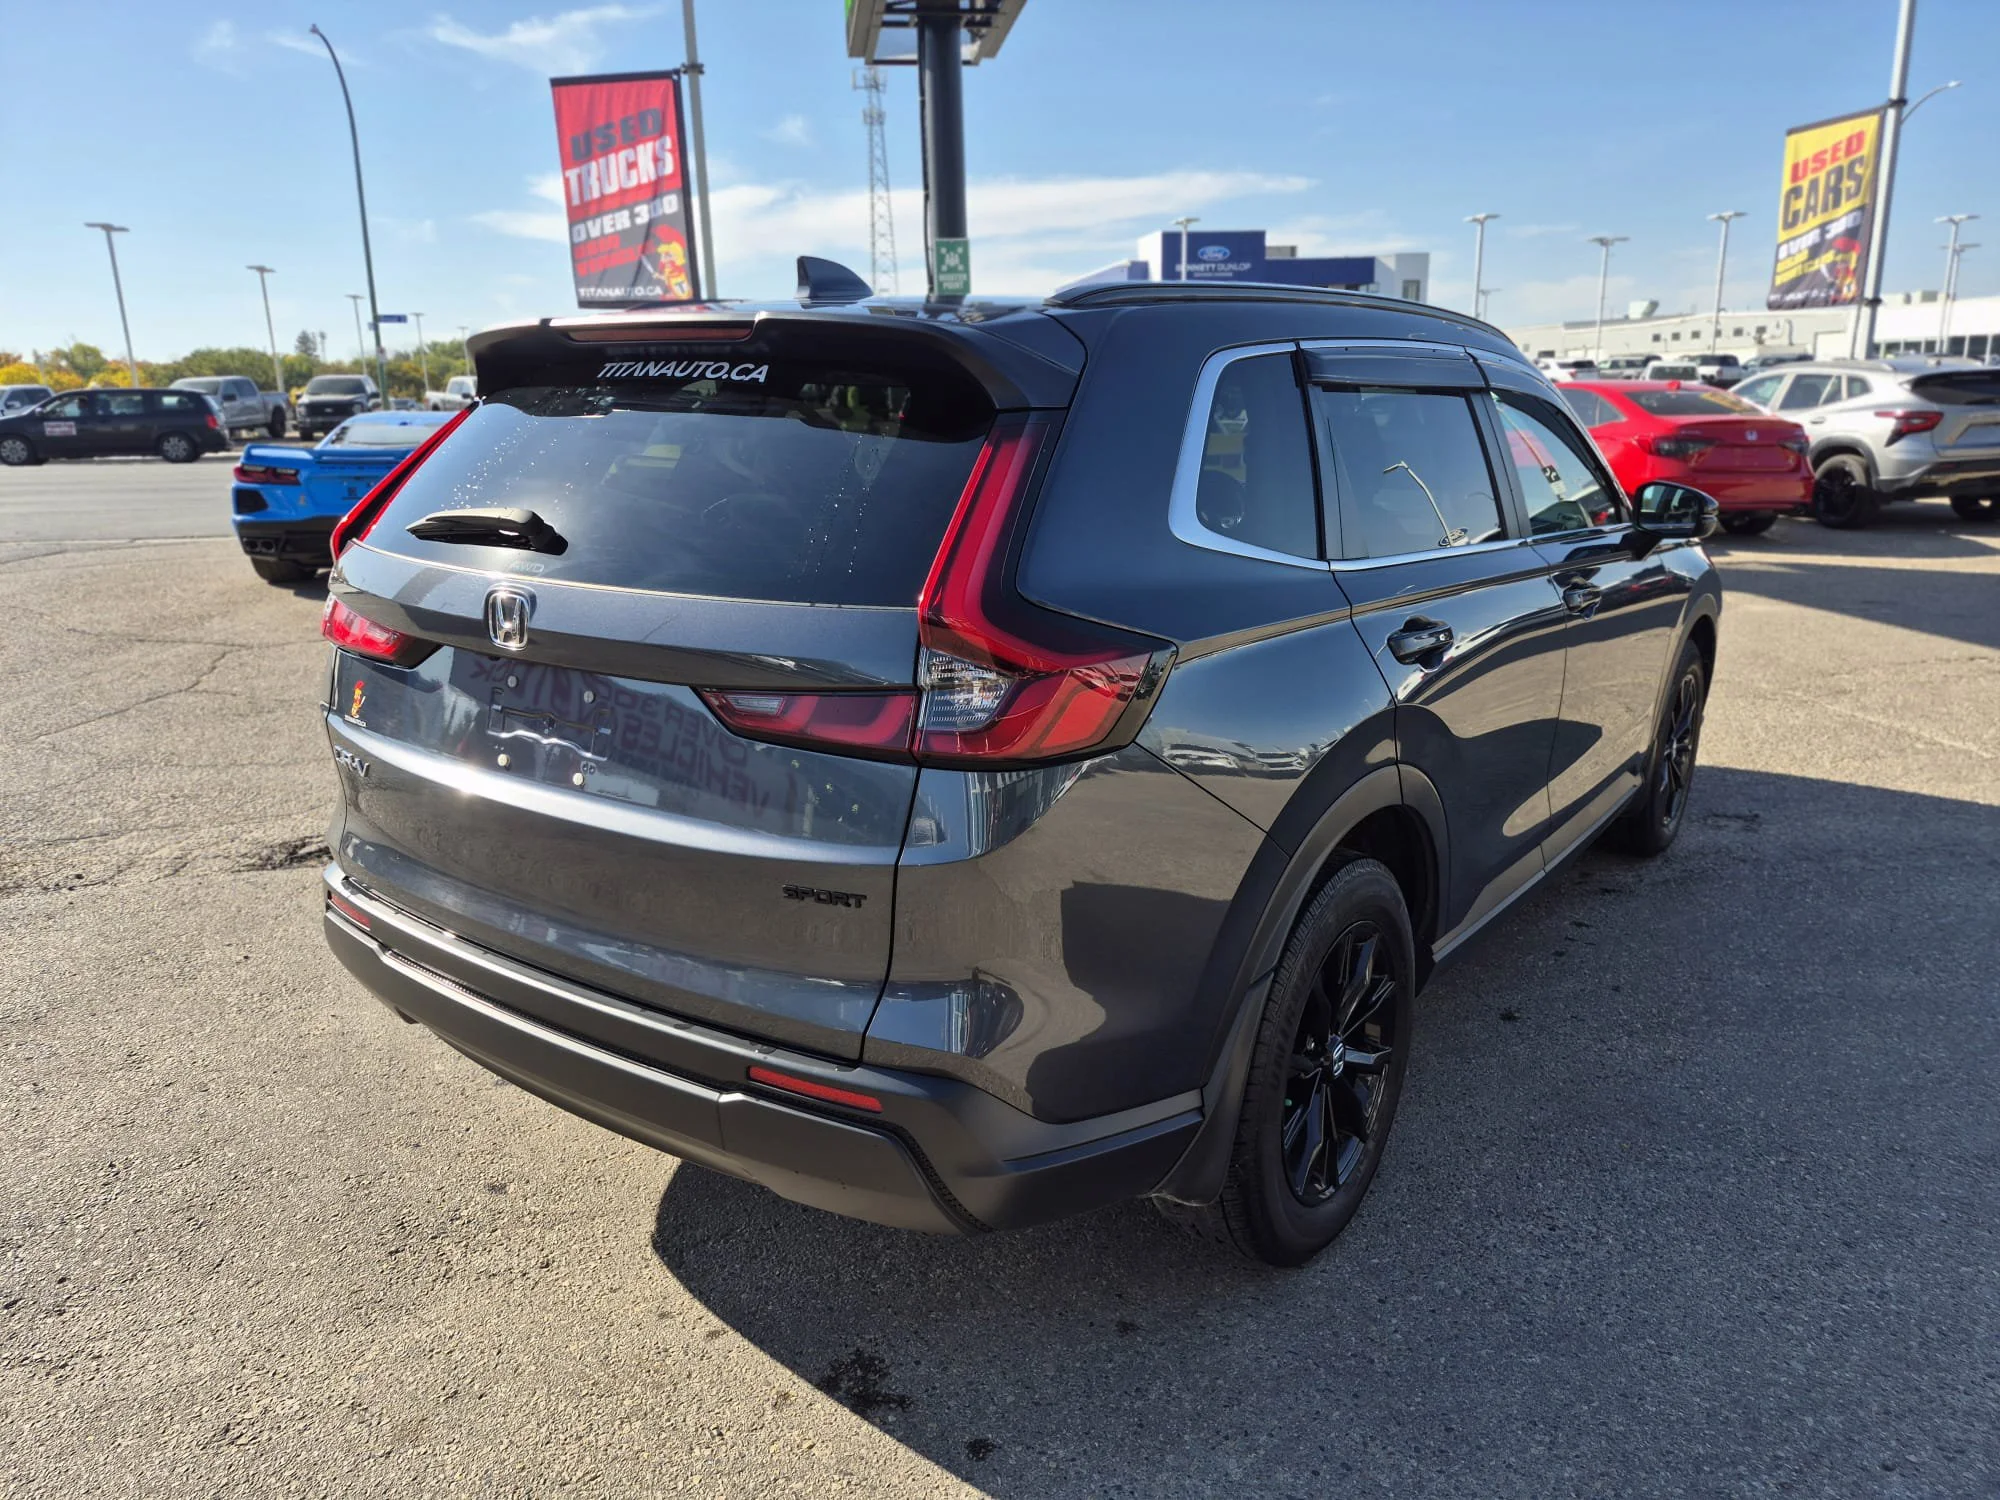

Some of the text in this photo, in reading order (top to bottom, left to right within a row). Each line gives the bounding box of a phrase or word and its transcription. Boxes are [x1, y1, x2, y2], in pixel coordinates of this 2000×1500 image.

[570, 107, 662, 161] USED
[1791, 130, 1865, 184] USED
[565, 135, 674, 207] TRUCKS
[1782, 155, 1865, 231] CARS
[571, 193, 678, 244] OVER 300
[597, 360, 769, 383] TITANAUTO.CA
[782, 884, 868, 908] SPORT
